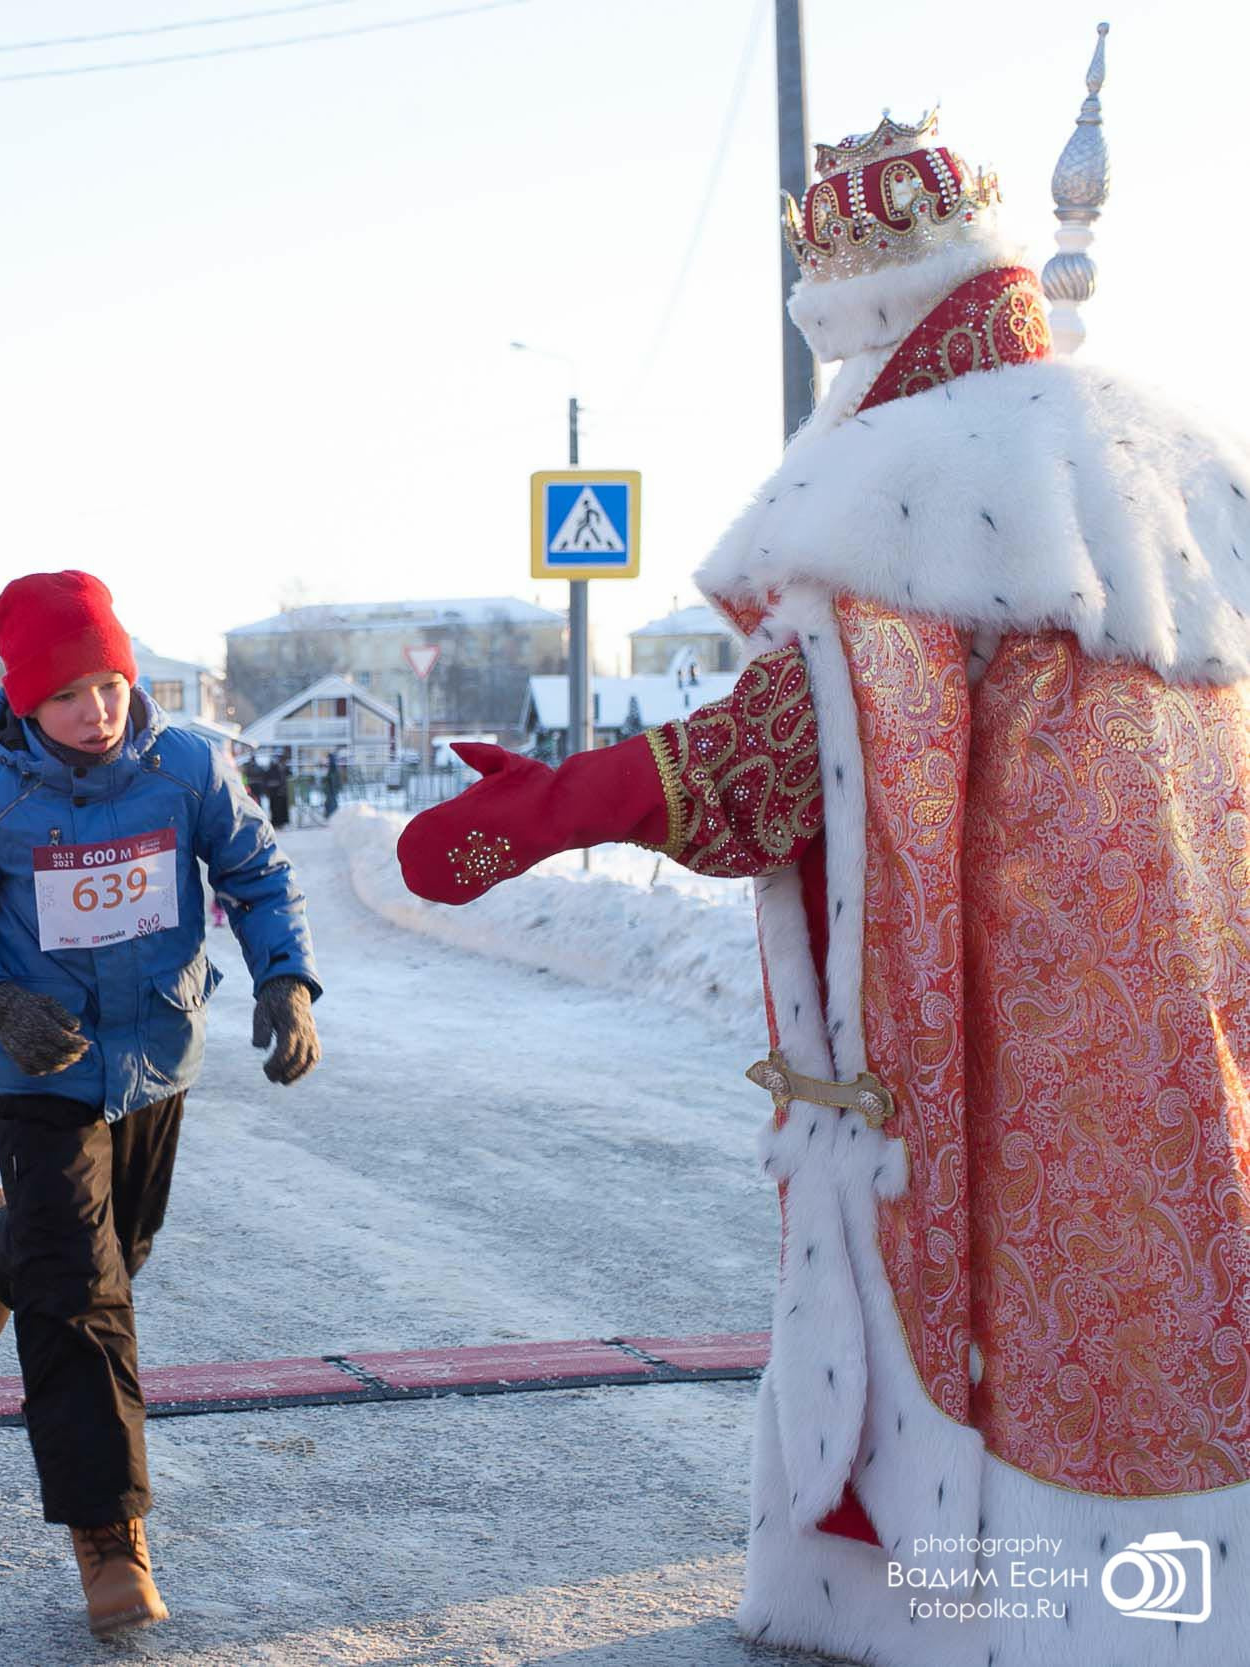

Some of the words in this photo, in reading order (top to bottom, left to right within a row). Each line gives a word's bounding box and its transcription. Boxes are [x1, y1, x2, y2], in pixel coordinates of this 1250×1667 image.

[52, 852, 74, 860] 05.12
[83, 848, 116, 866] 600
[120, 848, 132, 859] М
[53, 860, 74, 868] 2021
[73, 867, 147, 912] 639
